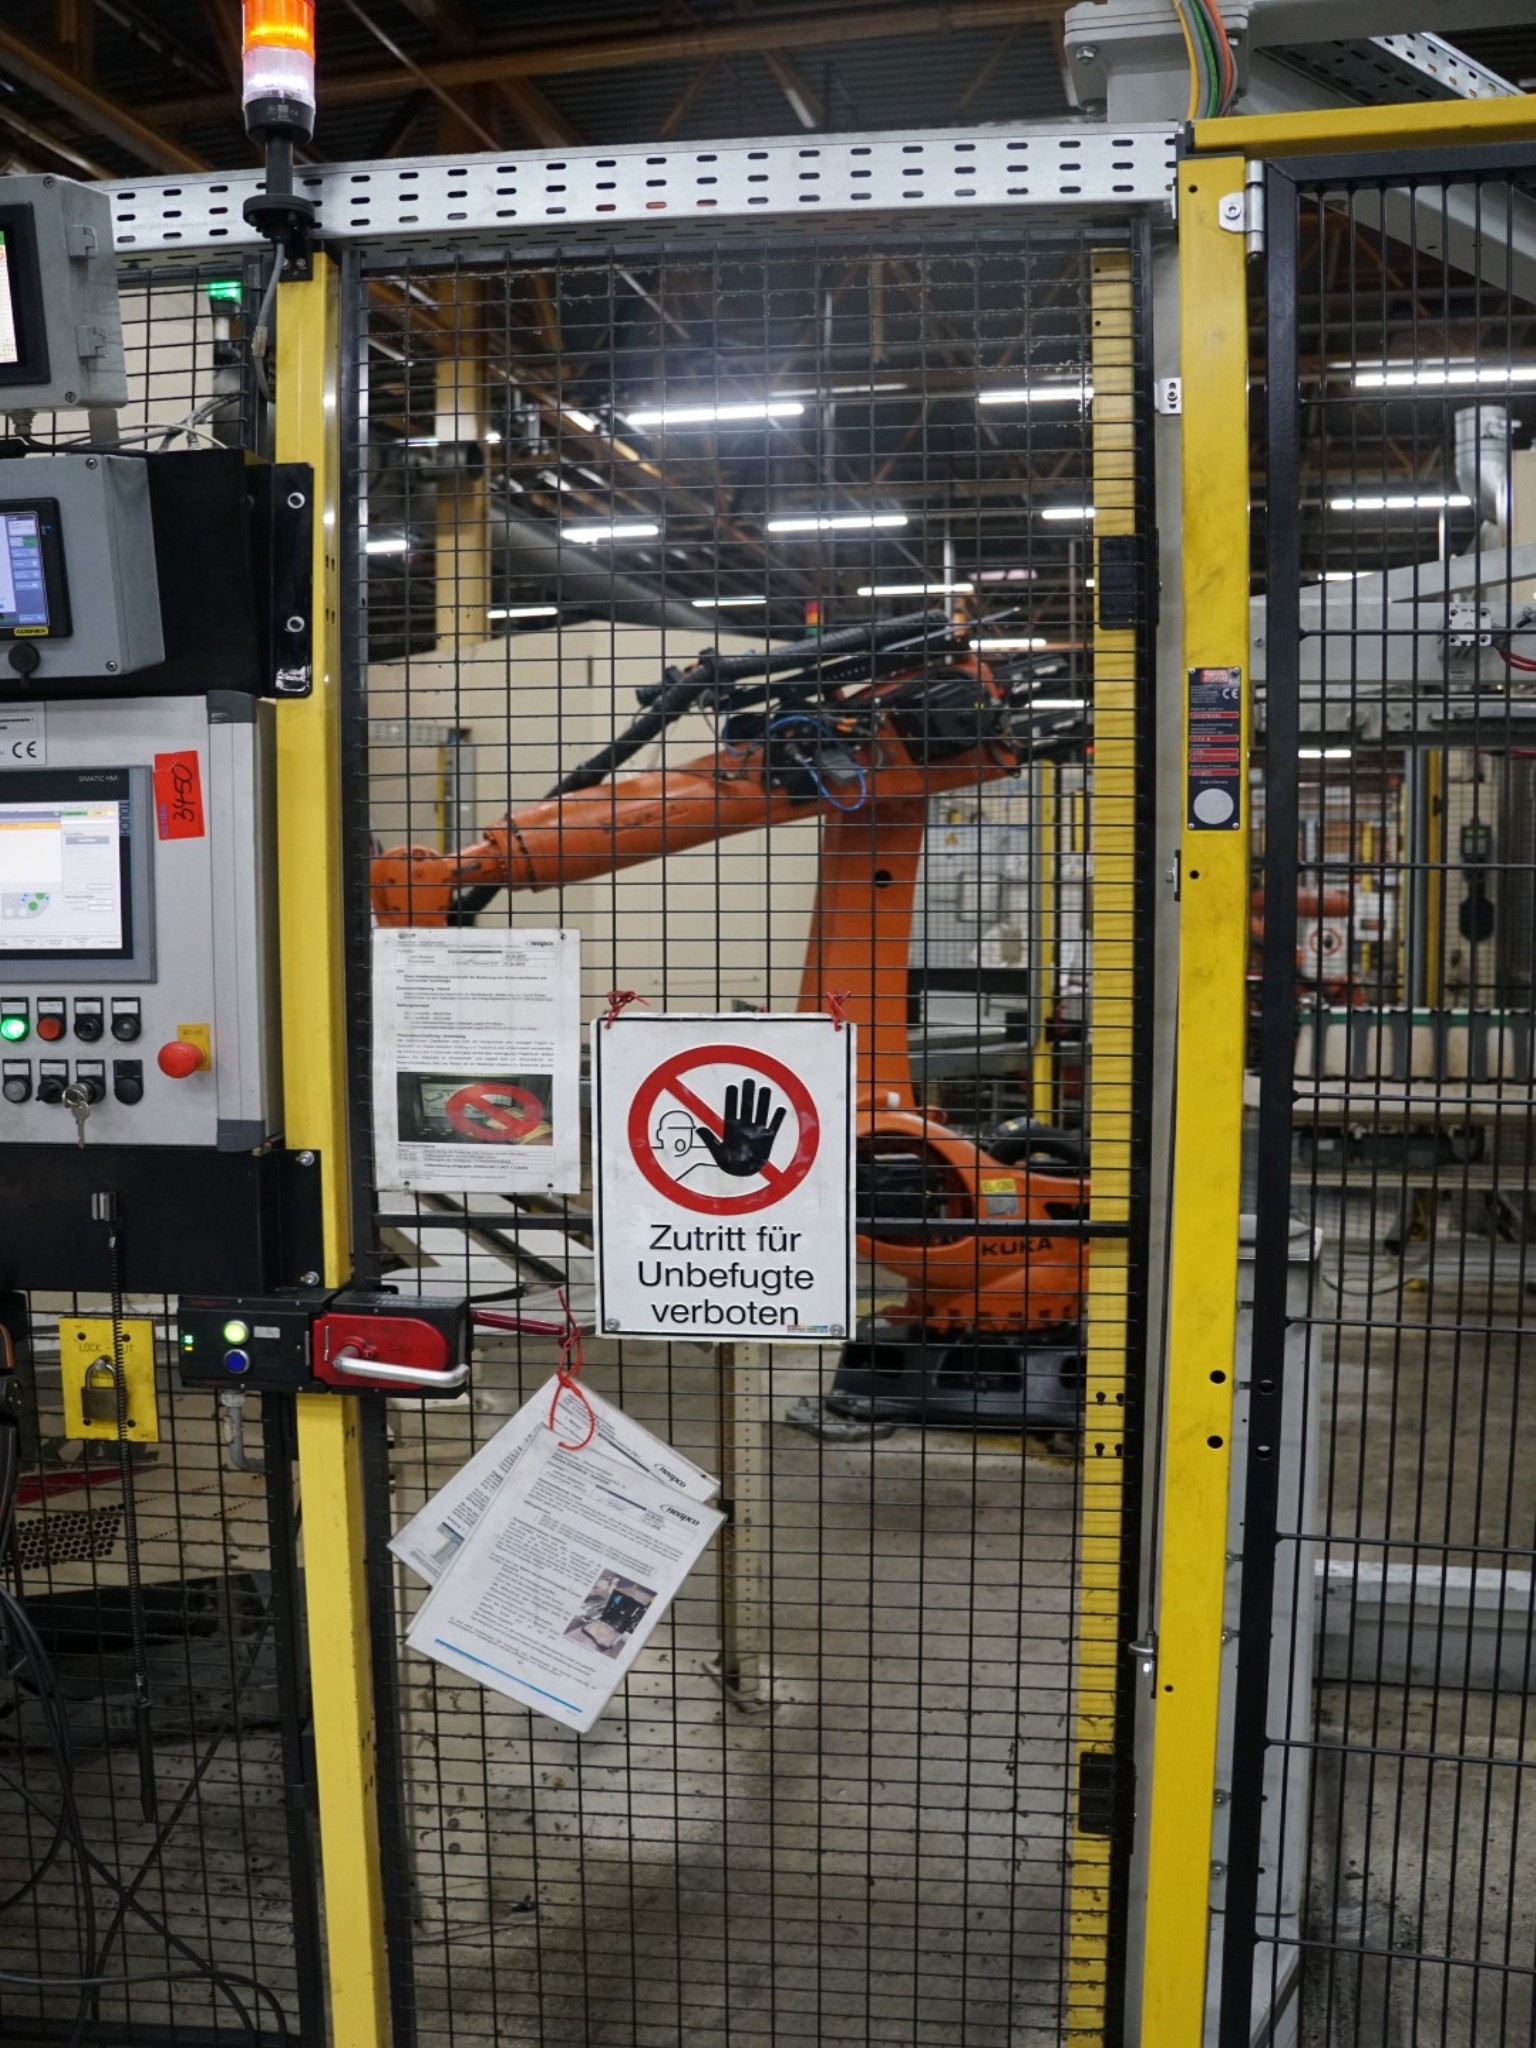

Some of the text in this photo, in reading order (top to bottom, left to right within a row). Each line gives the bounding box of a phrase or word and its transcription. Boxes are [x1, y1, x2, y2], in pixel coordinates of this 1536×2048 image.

[1222, 688, 1239, 700] CE
[12, 741, 37, 759] CE
[171, 763, 196, 823] 3450
[119, 800, 131, 836] TOUCH
[649, 1224, 802, 1252] Zutritt für
[981, 1237, 1053, 1256] KUKA
[638, 1260, 814, 1296] Unbefugte
[651, 1299, 799, 1326] verboten
[79, 1343, 102, 1352] LOCK
